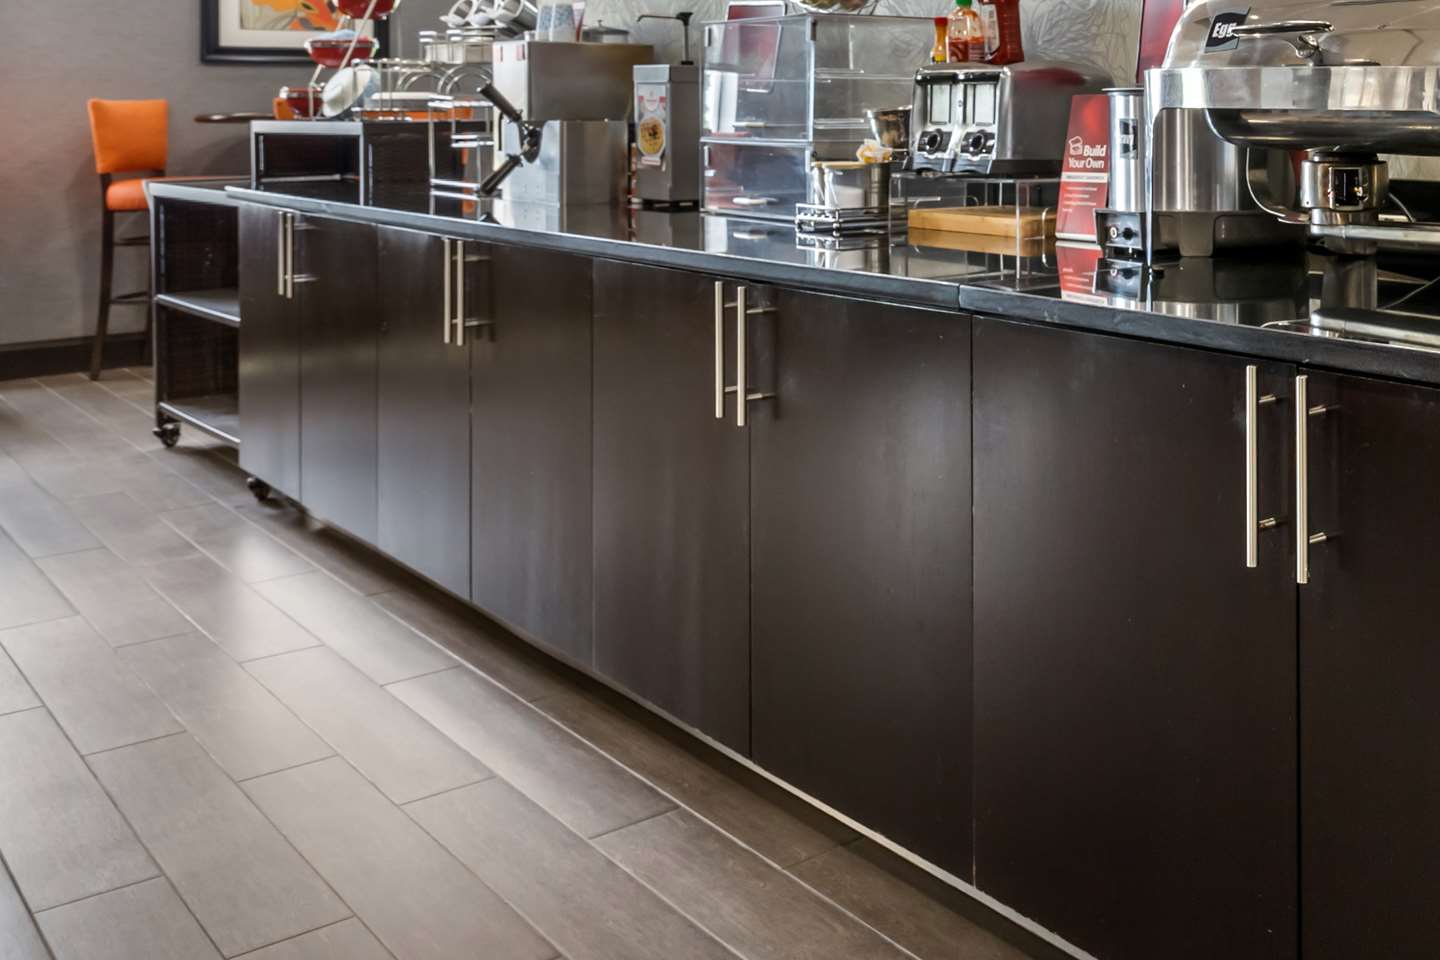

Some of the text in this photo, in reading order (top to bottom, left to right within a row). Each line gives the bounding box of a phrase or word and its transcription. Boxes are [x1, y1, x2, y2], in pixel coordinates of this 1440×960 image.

[1083, 144, 1107, 157] Build
[1068, 157, 1105, 169] Your Own
